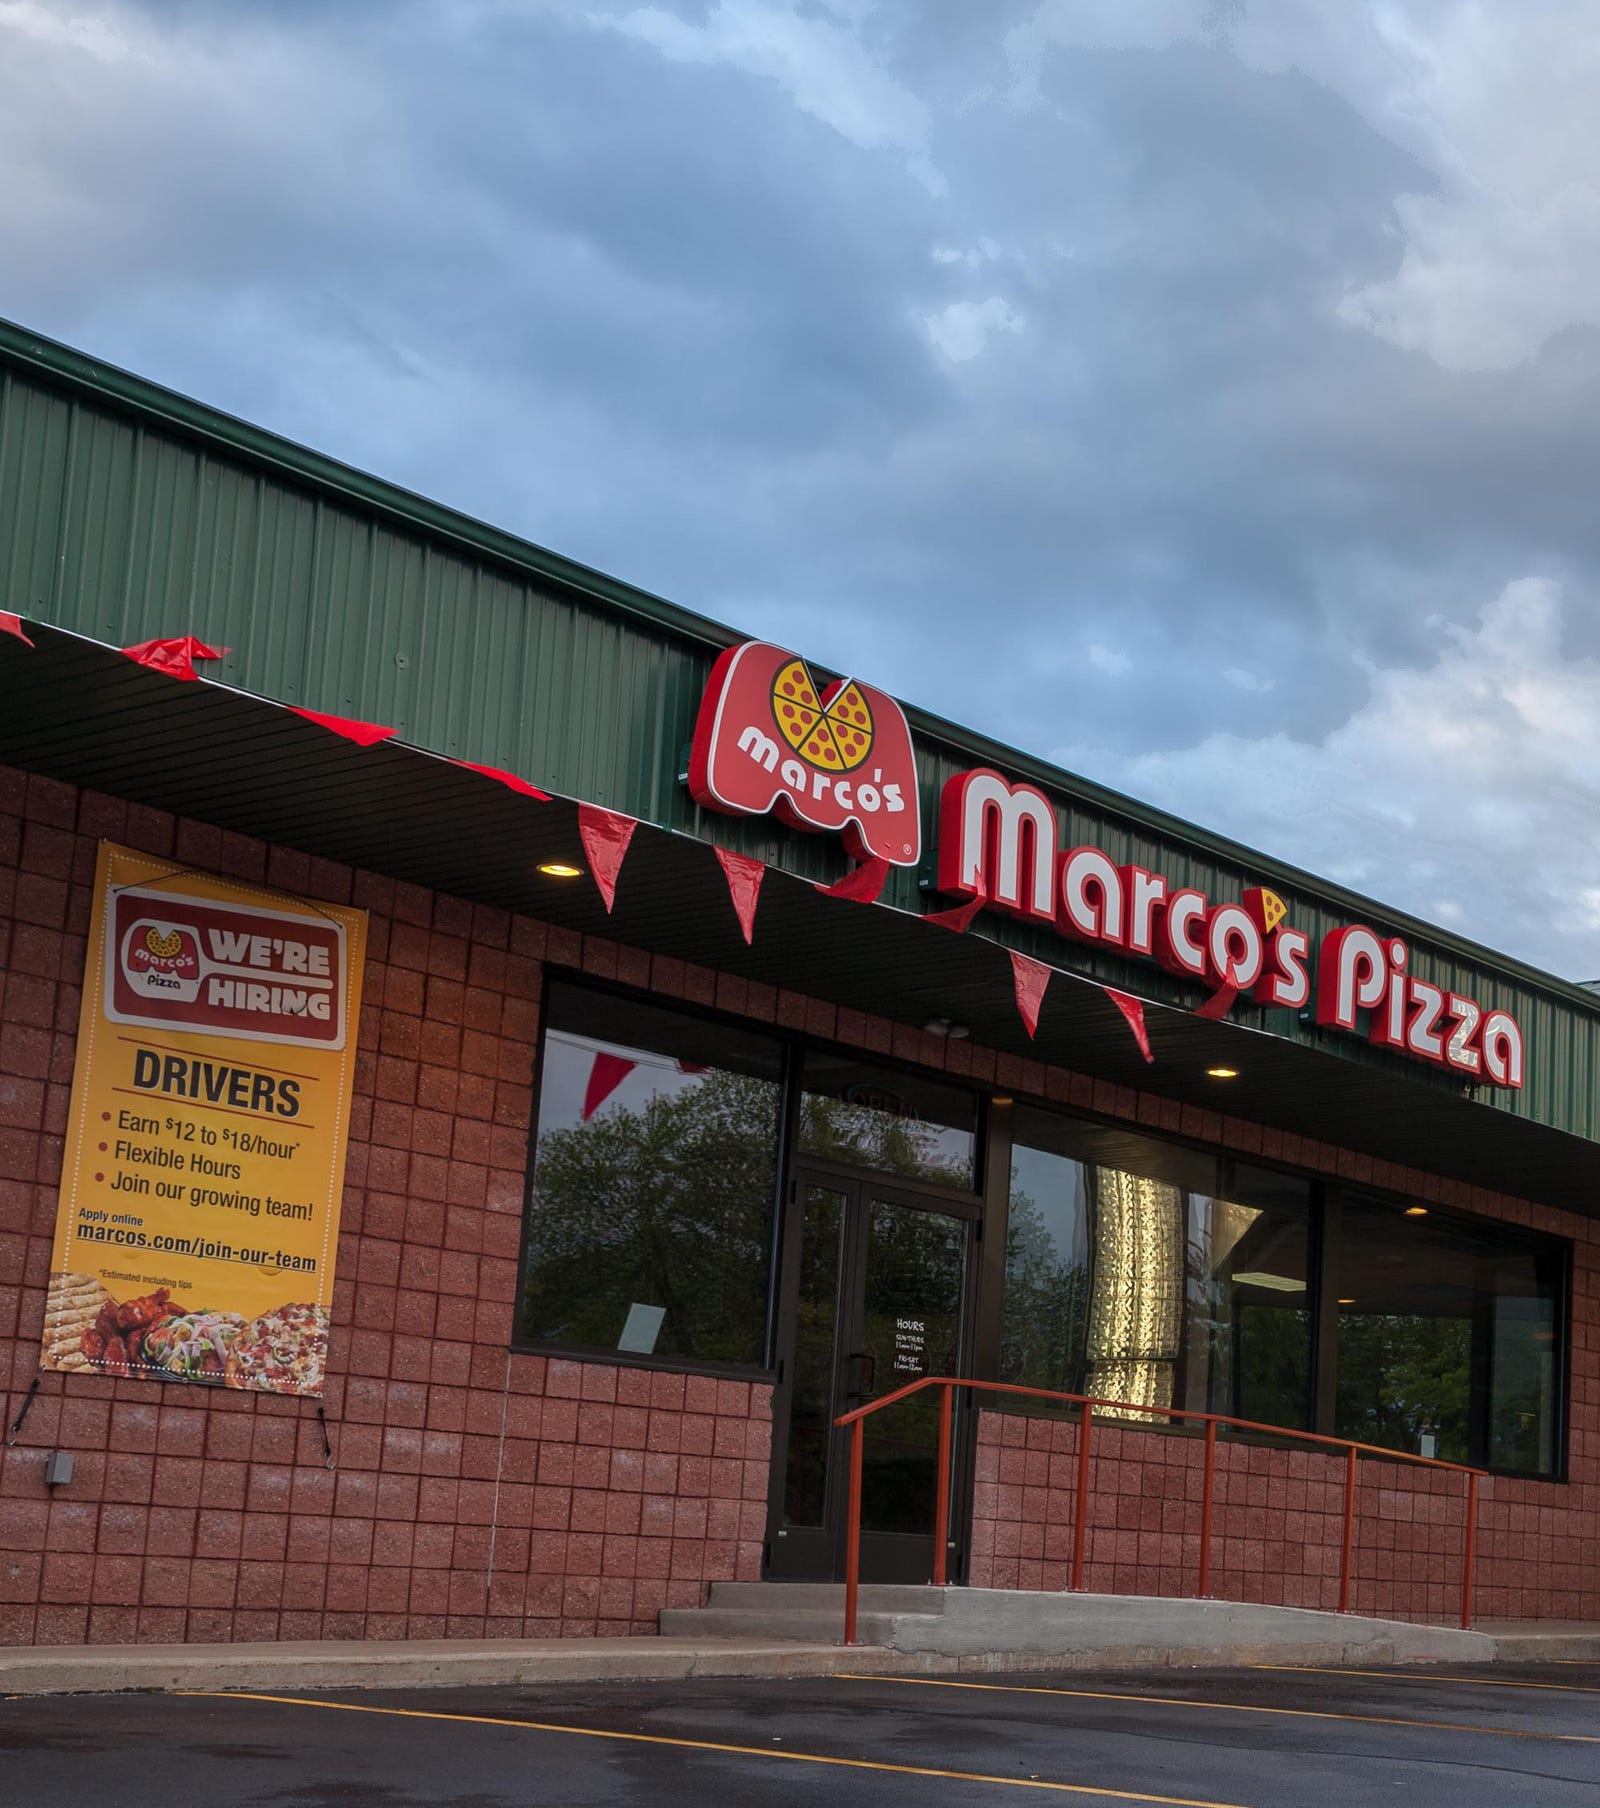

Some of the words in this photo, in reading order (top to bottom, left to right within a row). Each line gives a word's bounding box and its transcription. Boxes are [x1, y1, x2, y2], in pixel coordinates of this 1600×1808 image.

[957, 770, 1311, 1009] Marco's
[1333, 926, 1524, 1089] Pizza
[207, 928, 330, 976] WE'RE
[207, 978, 331, 1021] HIRING
[133, 1048, 301, 1118] DRIVERS
[118, 1109, 160, 1136] Earn
[165, 1117, 195, 1142] $12
[201, 1126, 217, 1146] to
[115, 1139, 185, 1170] Flexible
[190, 1152, 241, 1180] Hours
[78, 1207, 109, 1223] Apply
[112, 1213, 143, 1227] online
[111, 1171, 149, 1195] Join
[155, 1181, 186, 1200] our
[190, 1185, 261, 1217] growing
[266, 1196, 314, 1222] team!
[76, 1223, 317, 1272] marcos.com/join-our-team
[142, 1273, 177, 1288] including
[178, 1280, 193, 1290] tips
[896, 1318, 925, 1331] HOURS
